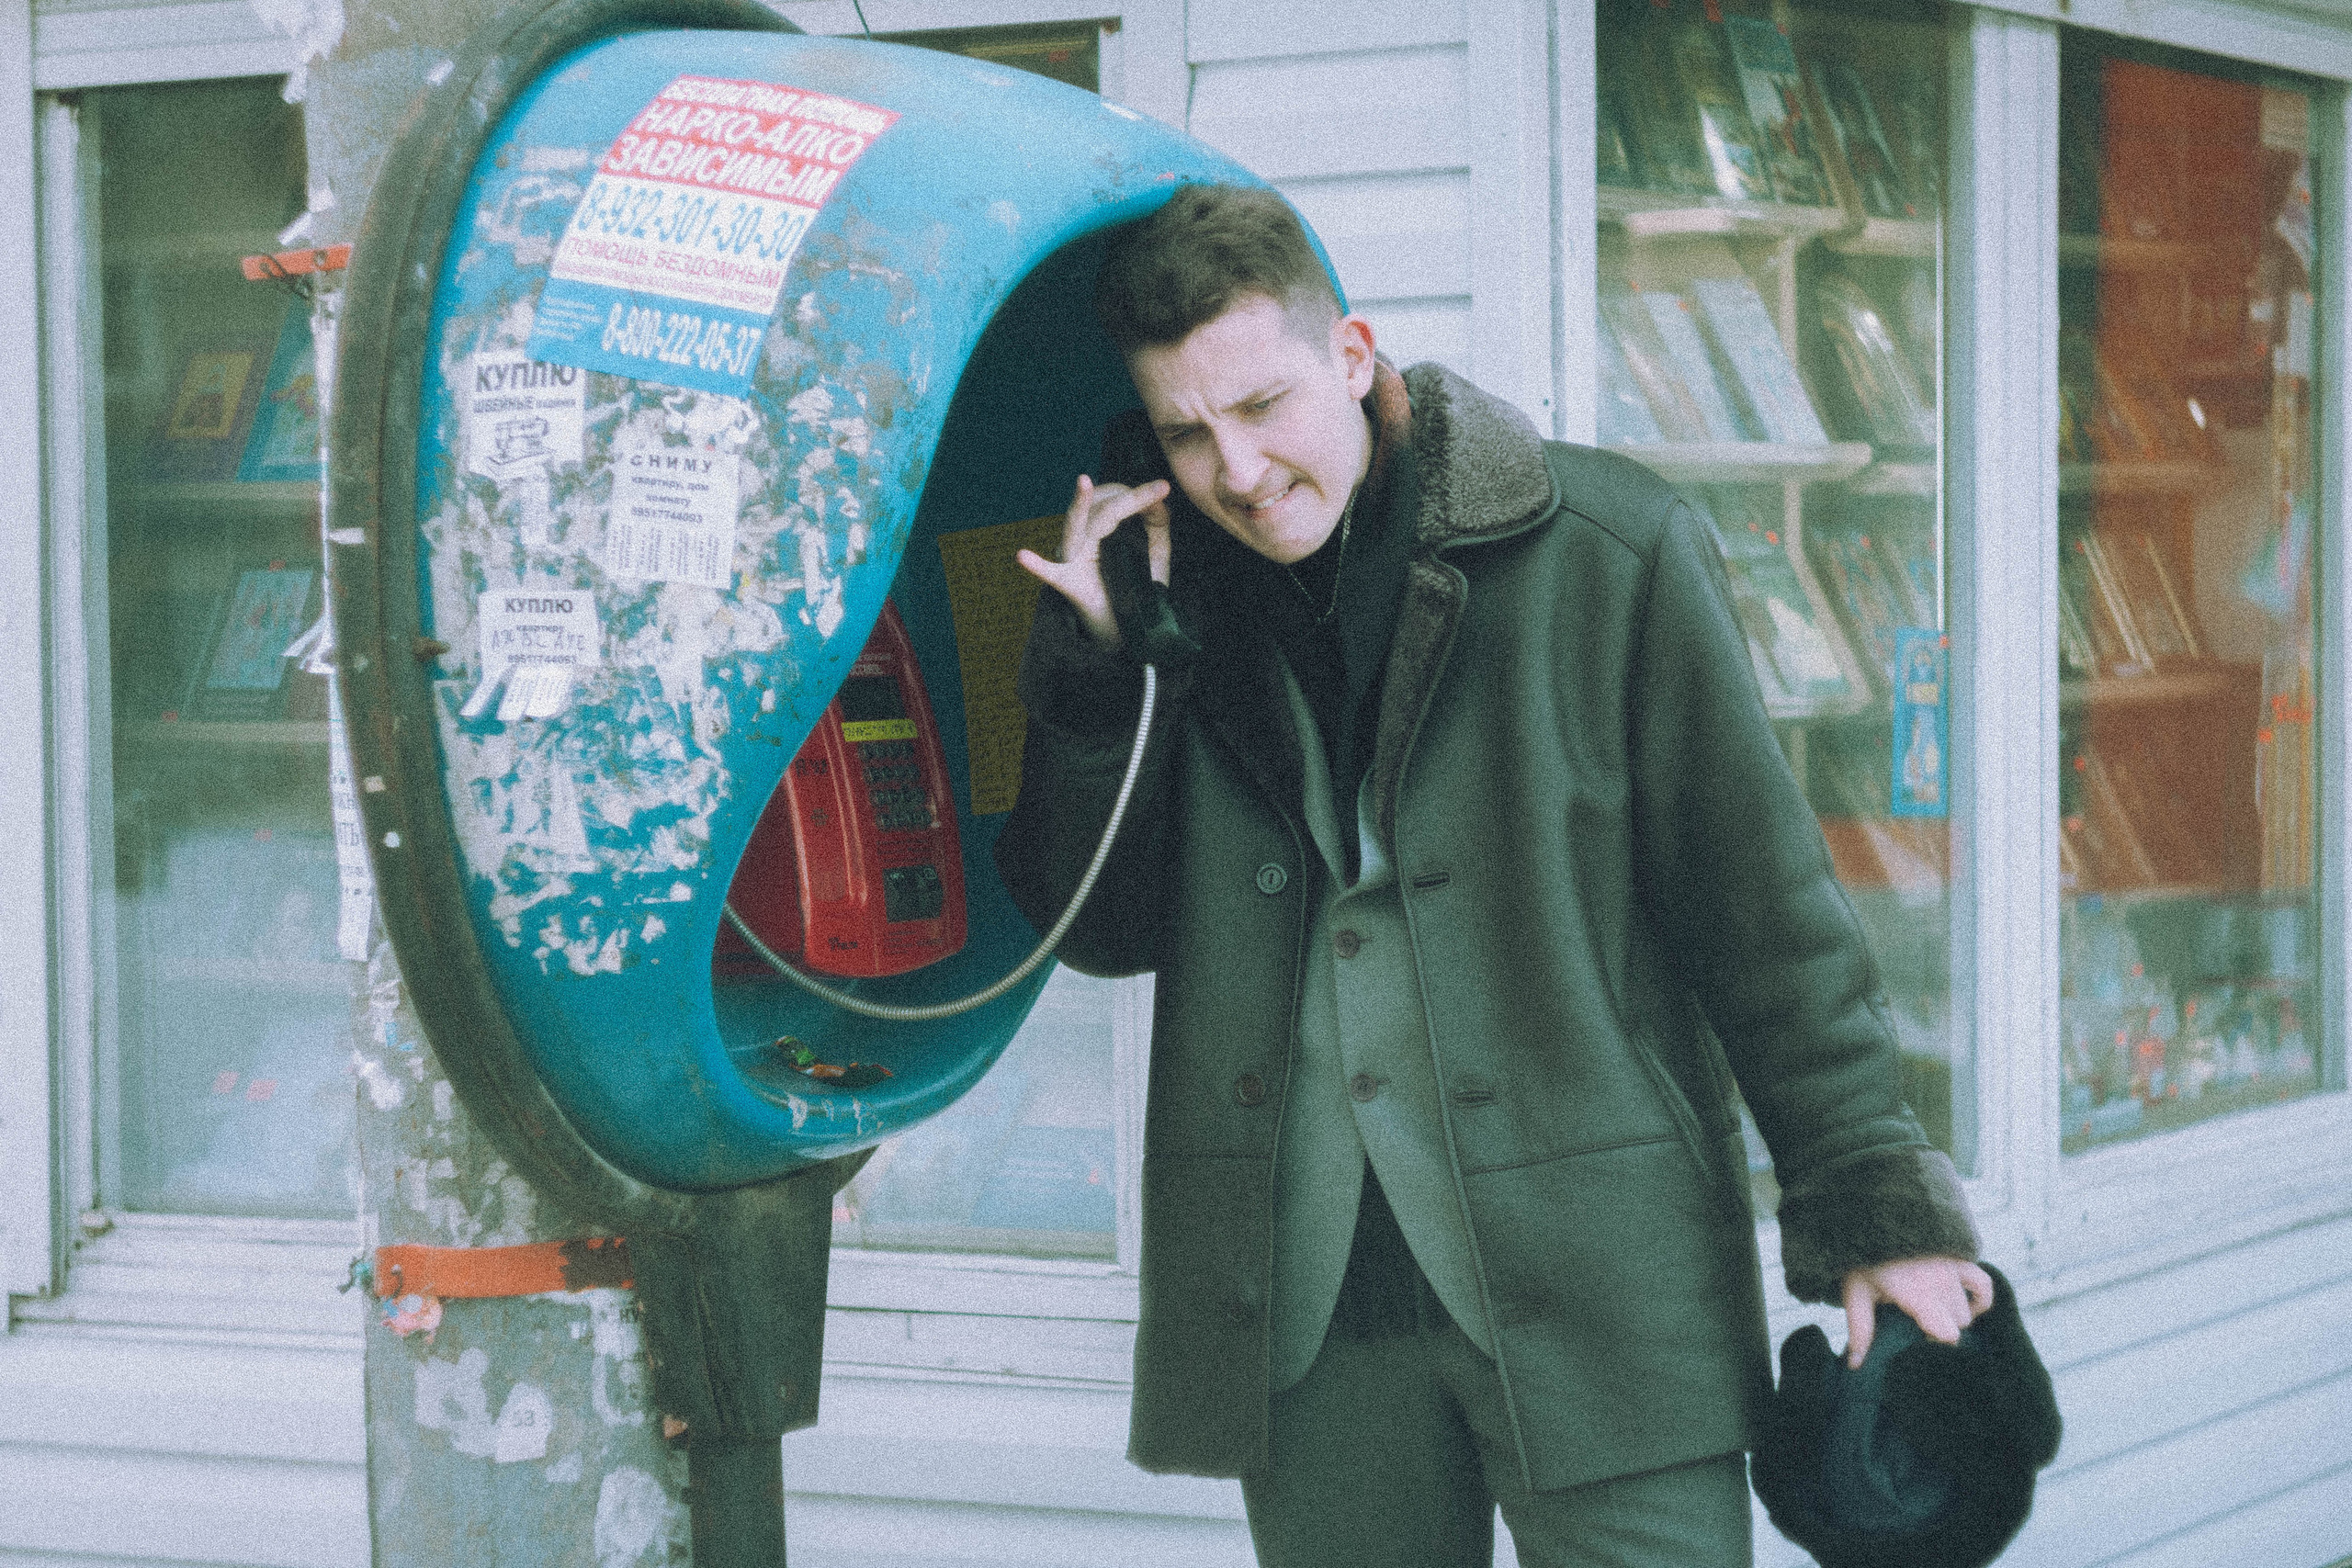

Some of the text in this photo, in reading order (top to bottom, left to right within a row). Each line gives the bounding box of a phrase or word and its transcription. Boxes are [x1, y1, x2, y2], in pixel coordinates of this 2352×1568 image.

[632, 101, 865, 164] НАРКО-АЛКО
[607, 134, 841, 204] ЗАВИСИМЫМ
[578, 182, 806, 262] 8-932-301-30-30
[562, 236, 650, 267] ПОМОЩЬ
[653, 250, 782, 289] БЕЗДОМНЫМ
[602, 301, 762, 378] 8-800-222-05-37
[475, 361, 578, 393] КУПЛЮ
[629, 453, 713, 473] СНИМУ
[504, 597, 574, 614] КУПЛЮ
